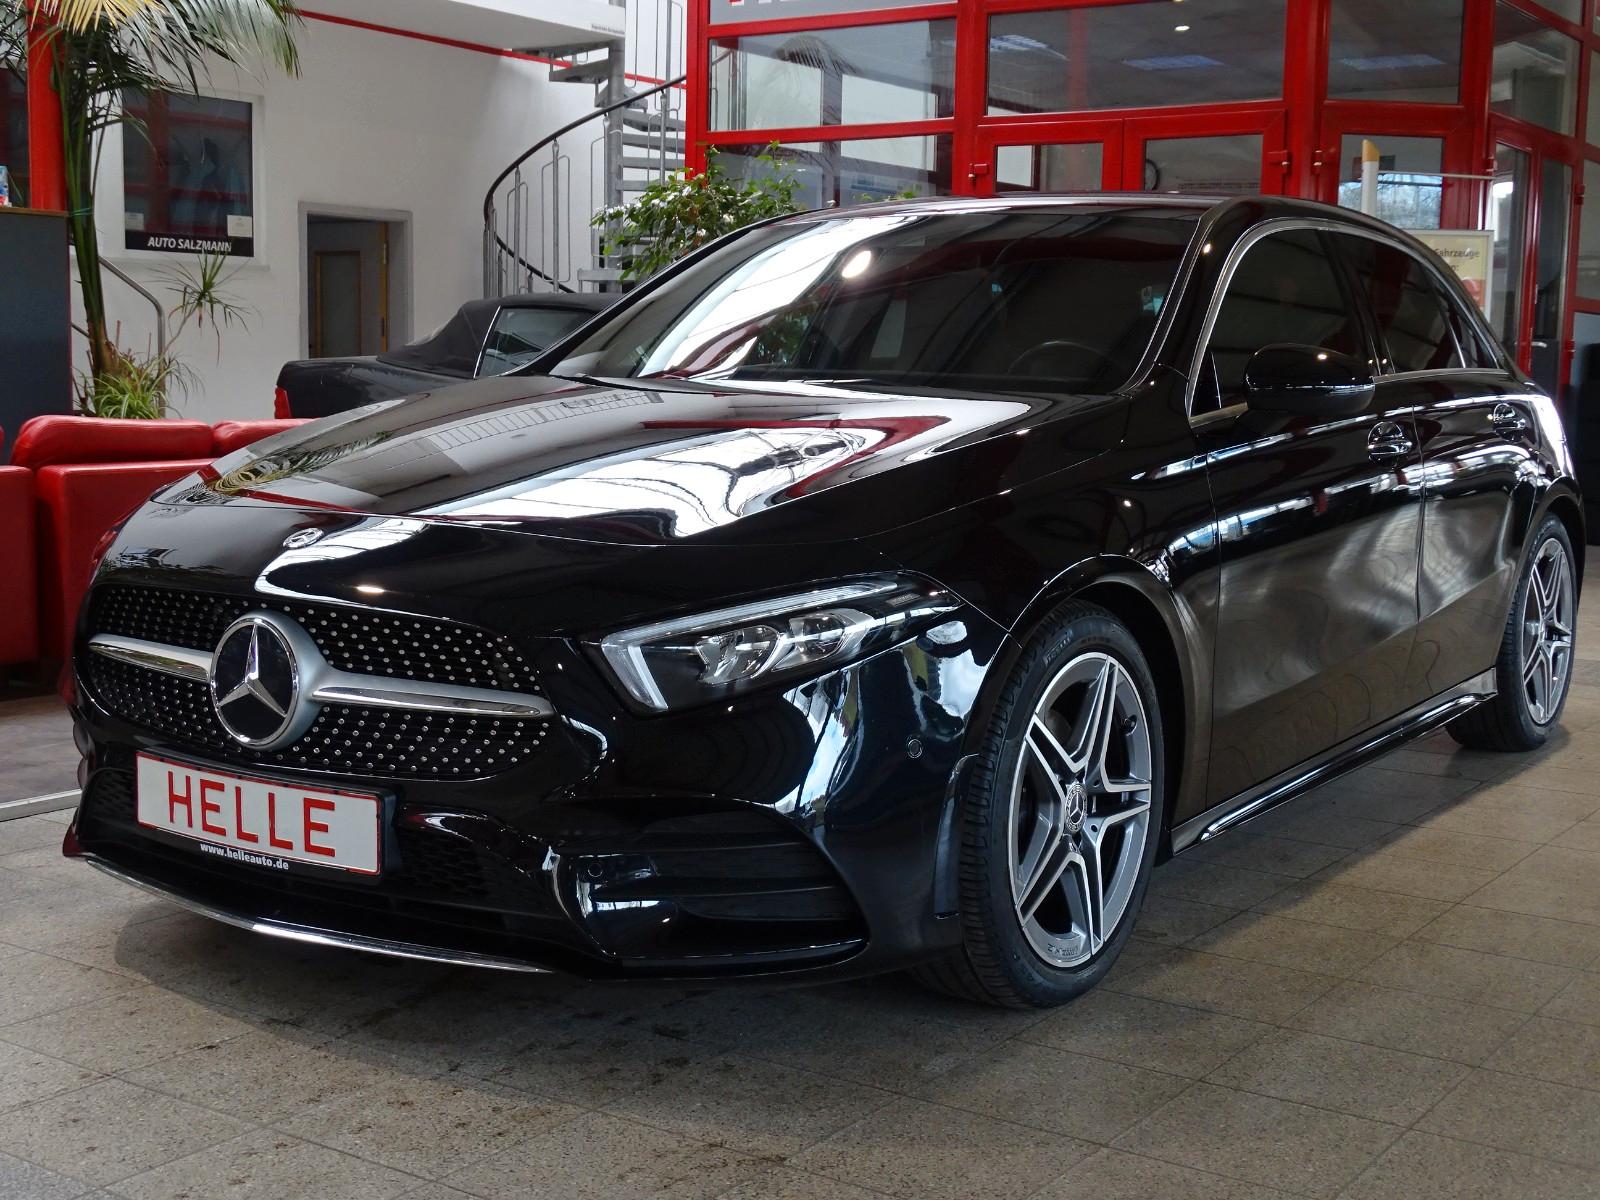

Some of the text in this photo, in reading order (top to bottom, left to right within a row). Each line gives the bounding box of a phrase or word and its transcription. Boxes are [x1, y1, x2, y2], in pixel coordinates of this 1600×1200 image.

[147, 236, 232, 252] AUTO SALZMANN
[167, 770, 336, 858] HELLE
[200, 843, 289, 870] www.helleauto.de
